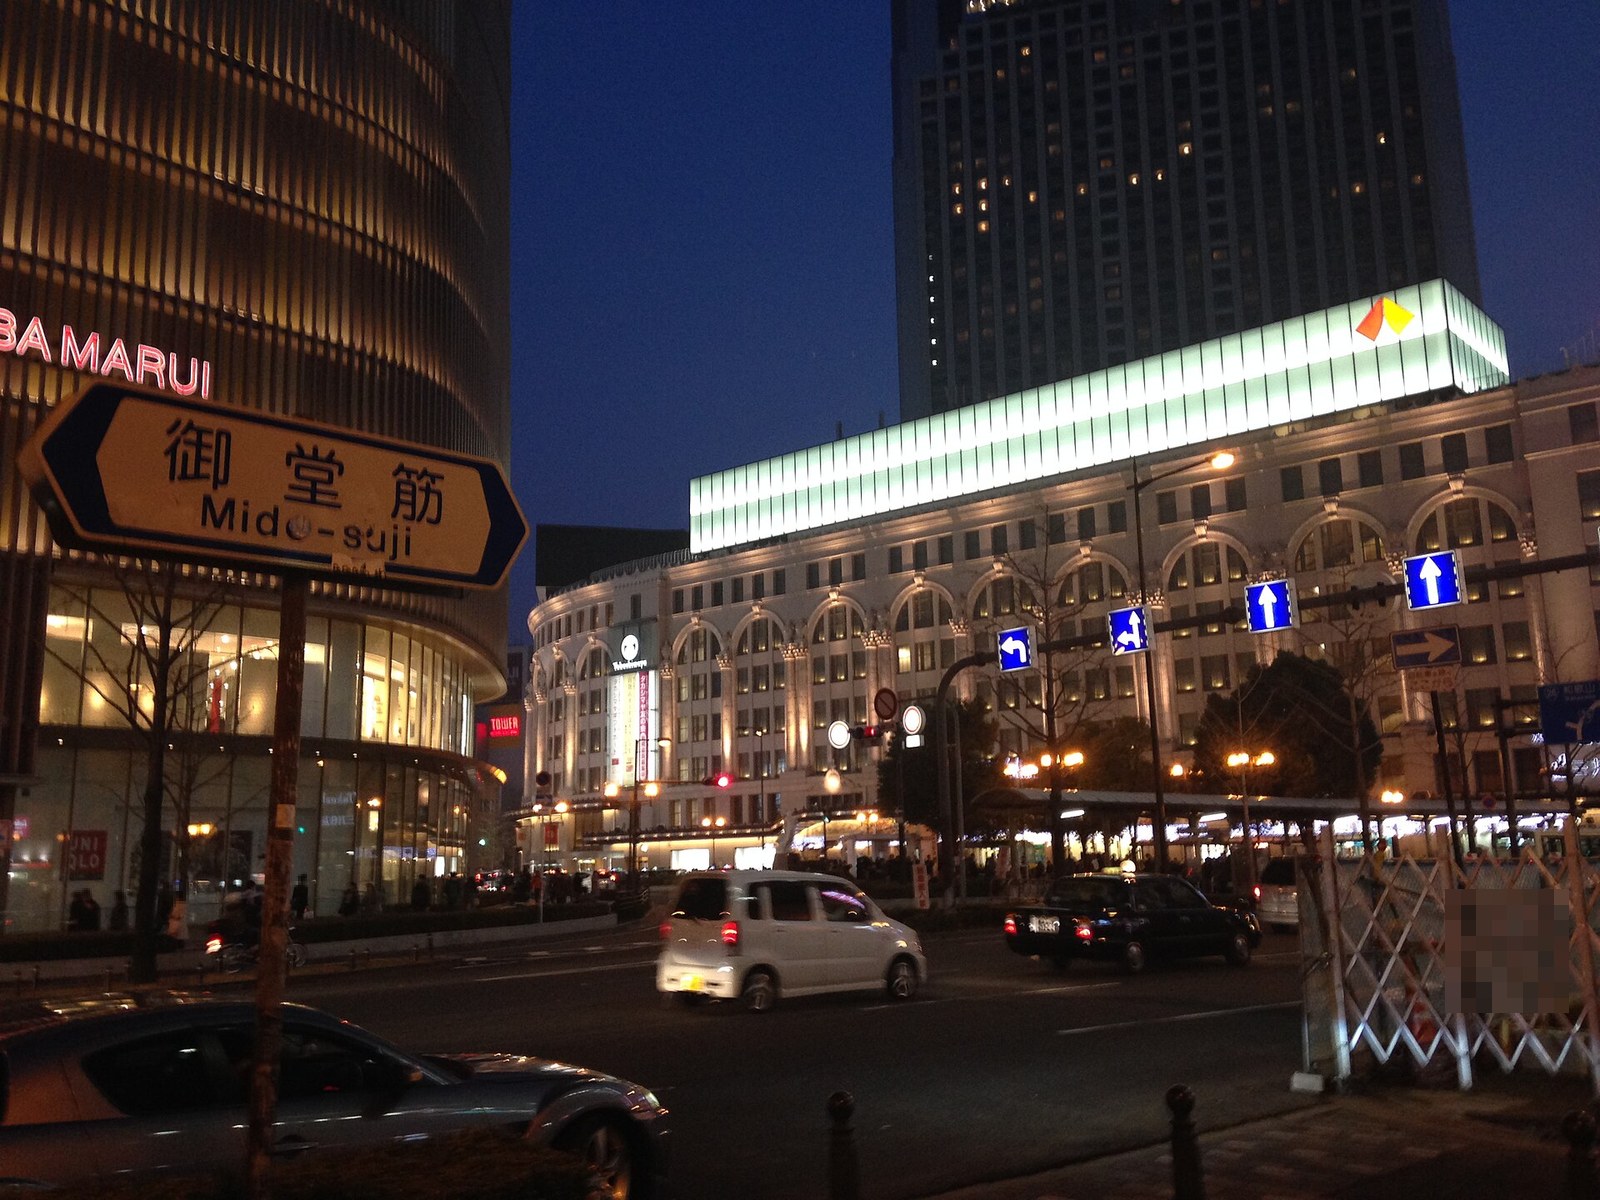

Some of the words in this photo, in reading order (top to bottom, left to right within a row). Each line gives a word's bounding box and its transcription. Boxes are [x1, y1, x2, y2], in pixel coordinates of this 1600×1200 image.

[61, 325, 210, 400] MARUI
[164, 417, 445, 525] 御堂筋
[490, 717, 519, 731] TOWER
